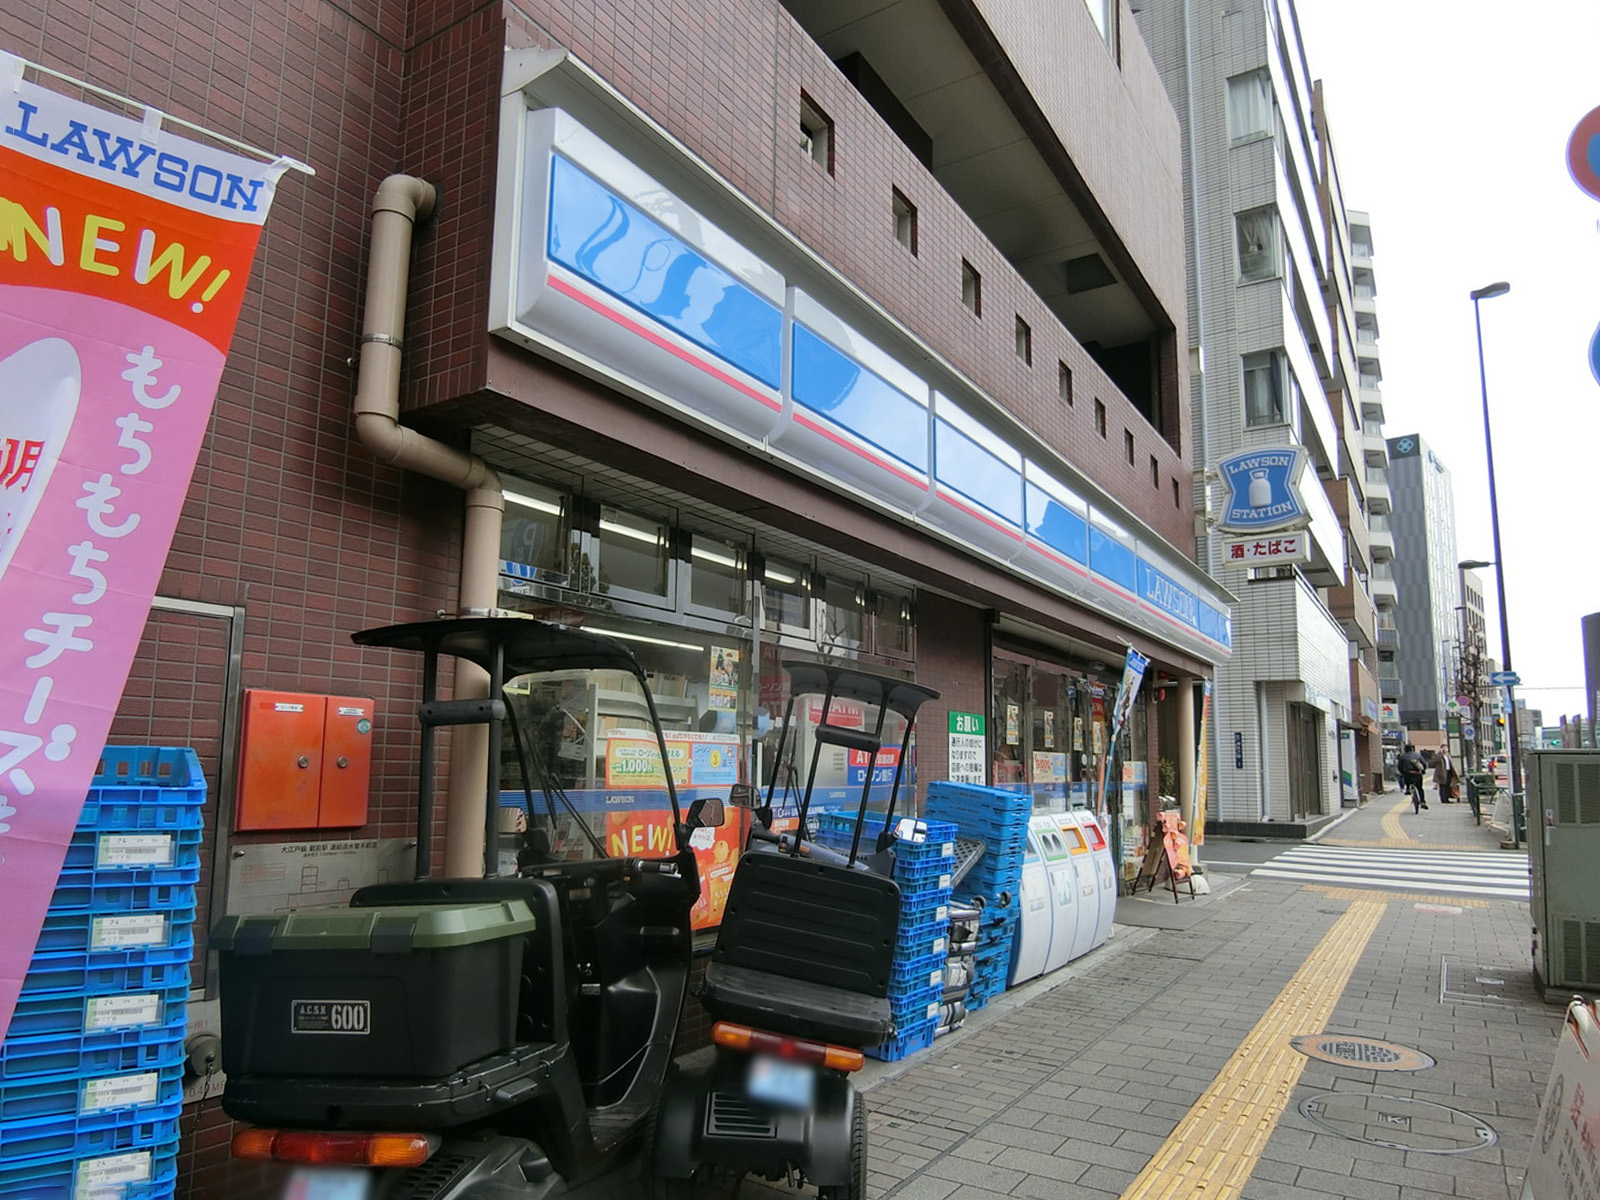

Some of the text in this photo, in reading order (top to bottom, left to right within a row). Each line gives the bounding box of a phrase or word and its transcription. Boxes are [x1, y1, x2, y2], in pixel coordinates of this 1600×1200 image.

[5, 100, 265, 213] LAWSON
[12, 202, 231, 314] NEW!
[1228, 455, 1290, 475] LAWSON
[1231, 501, 1293, 520] STATION
[1230, 540, 1297, 560] 酒・たばこ
[1145, 567, 1197, 628] LAWSON
[956, 715, 979, 732] お願い
[612, 824, 673, 857] NEW!
[331, 1004, 365, 1030] 600
